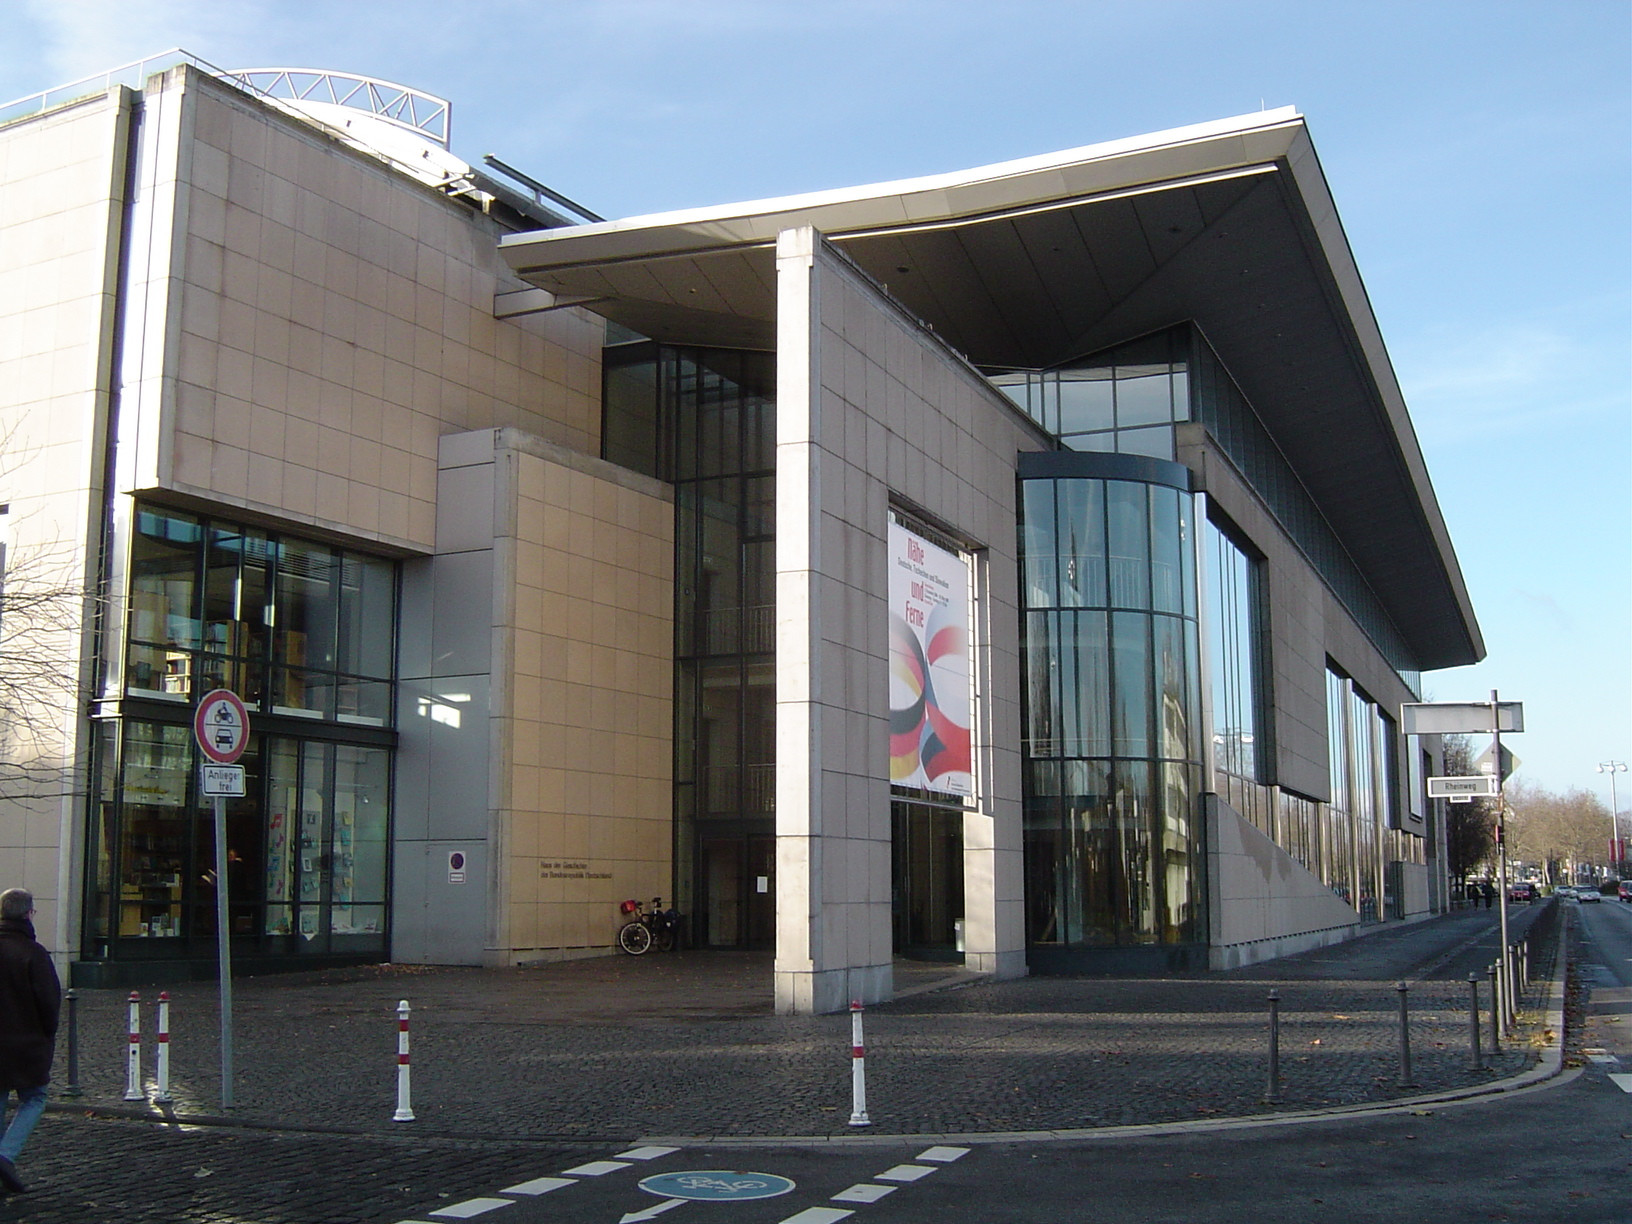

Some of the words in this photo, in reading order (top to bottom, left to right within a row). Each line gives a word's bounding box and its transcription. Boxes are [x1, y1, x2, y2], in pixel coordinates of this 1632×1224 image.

[908, 537, 924, 566] Nähe
[911, 580, 924, 602] und
[905, 600, 924, 628] Ferne
[208, 769, 241, 782] Anlieger
[219, 781, 233, 791] frei
[1444, 782, 1477, 791] Rheinweg
